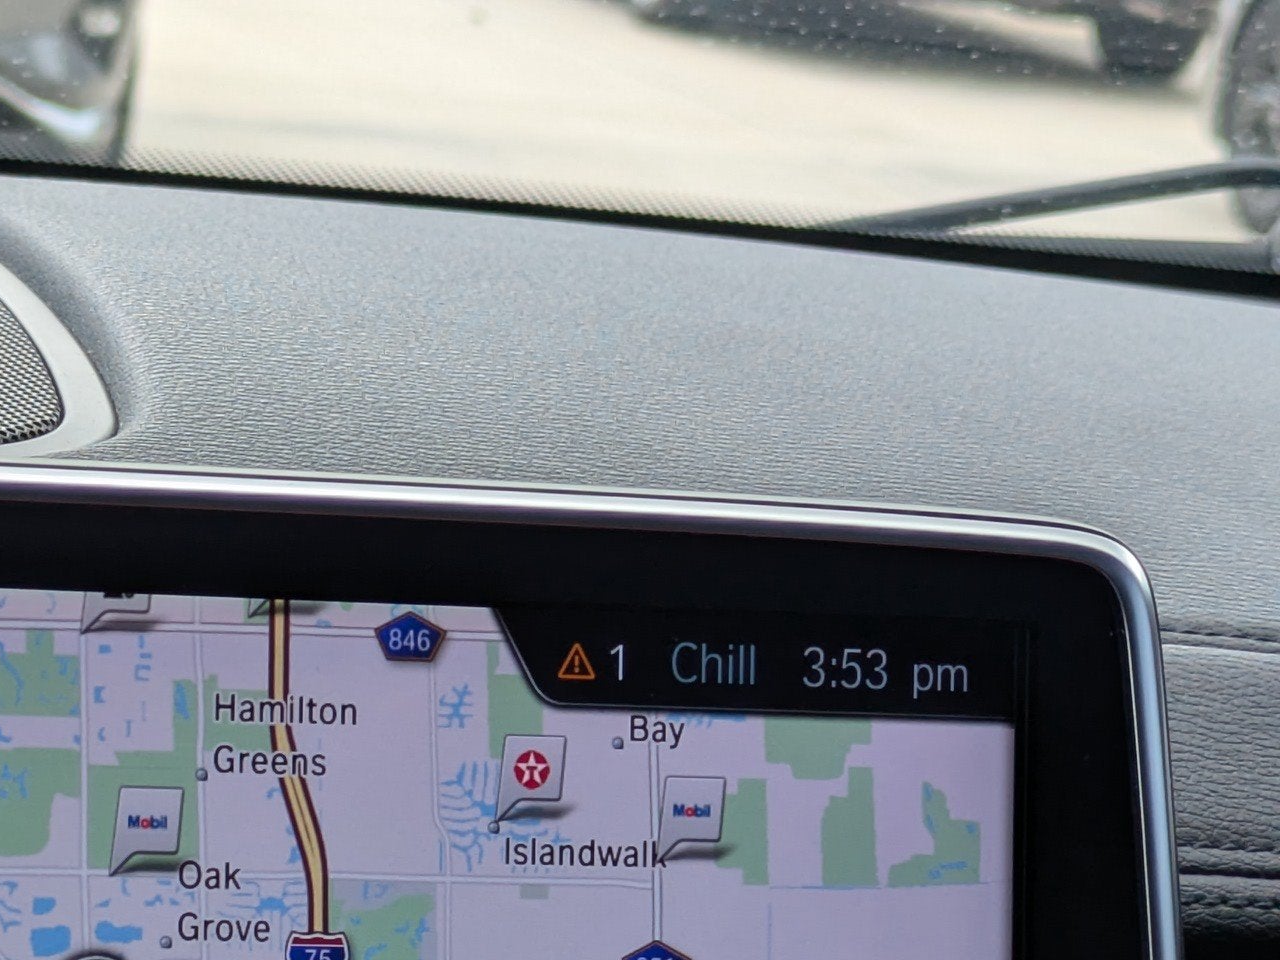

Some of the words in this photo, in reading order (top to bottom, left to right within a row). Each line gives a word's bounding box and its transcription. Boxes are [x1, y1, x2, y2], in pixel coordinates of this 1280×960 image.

[388, 629, 431, 652] 846
[610, 645, 625, 681] 1
[671, 641, 757, 685] Chill
[802, 647, 889, 690] 3:53
[913, 662, 969, 699] pm
[214, 693, 358, 726] Hamilton
[630, 714, 685, 749] Bay
[213, 744, 327, 777] Greens
[127, 814, 168, 831] Mobil
[672, 803, 711, 818] Mobil
[504, 838, 667, 869] Islandwalk
[178, 862, 242, 890] Oak
[177, 912, 271, 943] Grove
